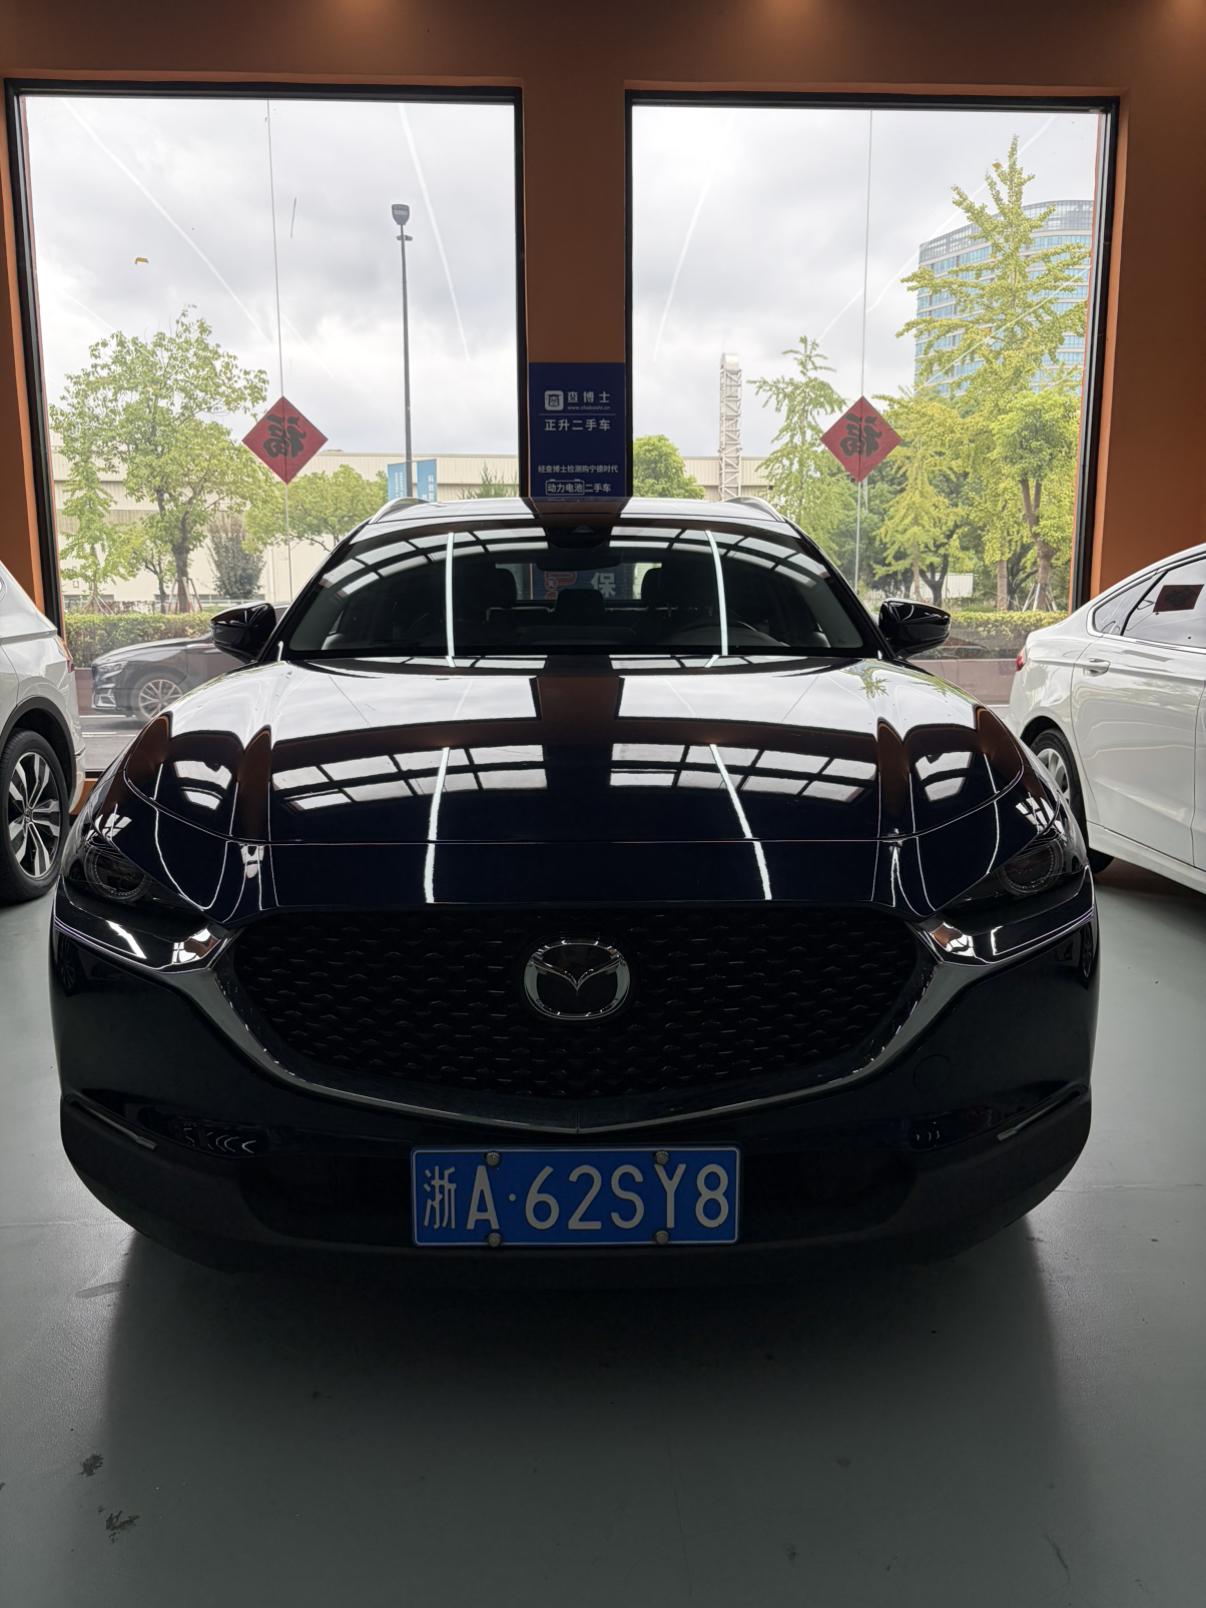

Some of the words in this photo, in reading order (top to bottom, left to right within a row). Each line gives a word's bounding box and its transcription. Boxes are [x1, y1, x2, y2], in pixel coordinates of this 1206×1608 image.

[544, 418, 611, 431] 正升二手车
[547, 483, 611, 493] 动力电池二手车
[424, 1163, 729, 1230] 浙A·62SY8
